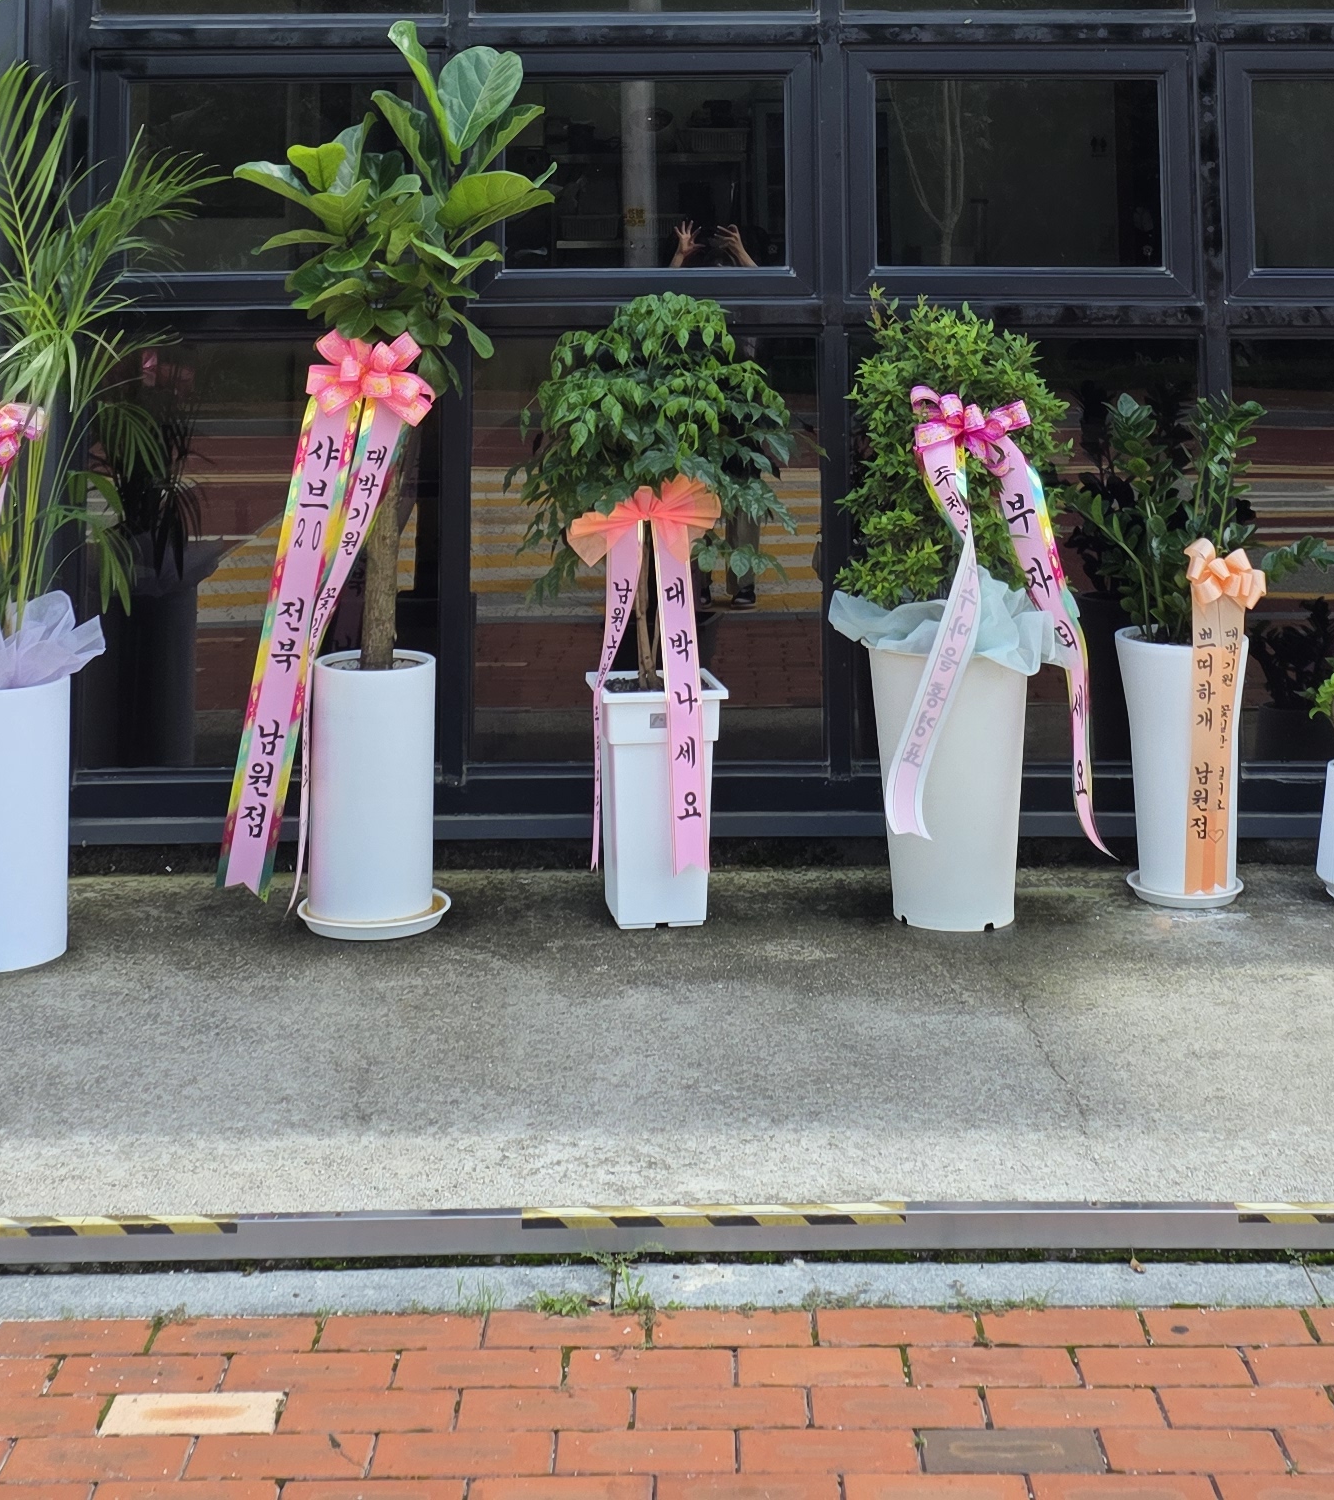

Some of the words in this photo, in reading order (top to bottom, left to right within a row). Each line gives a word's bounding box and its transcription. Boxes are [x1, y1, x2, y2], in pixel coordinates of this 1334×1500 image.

[340, 445, 388, 556] 대박기원
[271, 597, 304, 673] 전북
[1196, 627, 1216, 732] 쁘띠하개
[1222, 626, 1238, 687] 대박기원
[239, 719, 285, 839] 남원점
[1190, 761, 1213, 839] 남원점
